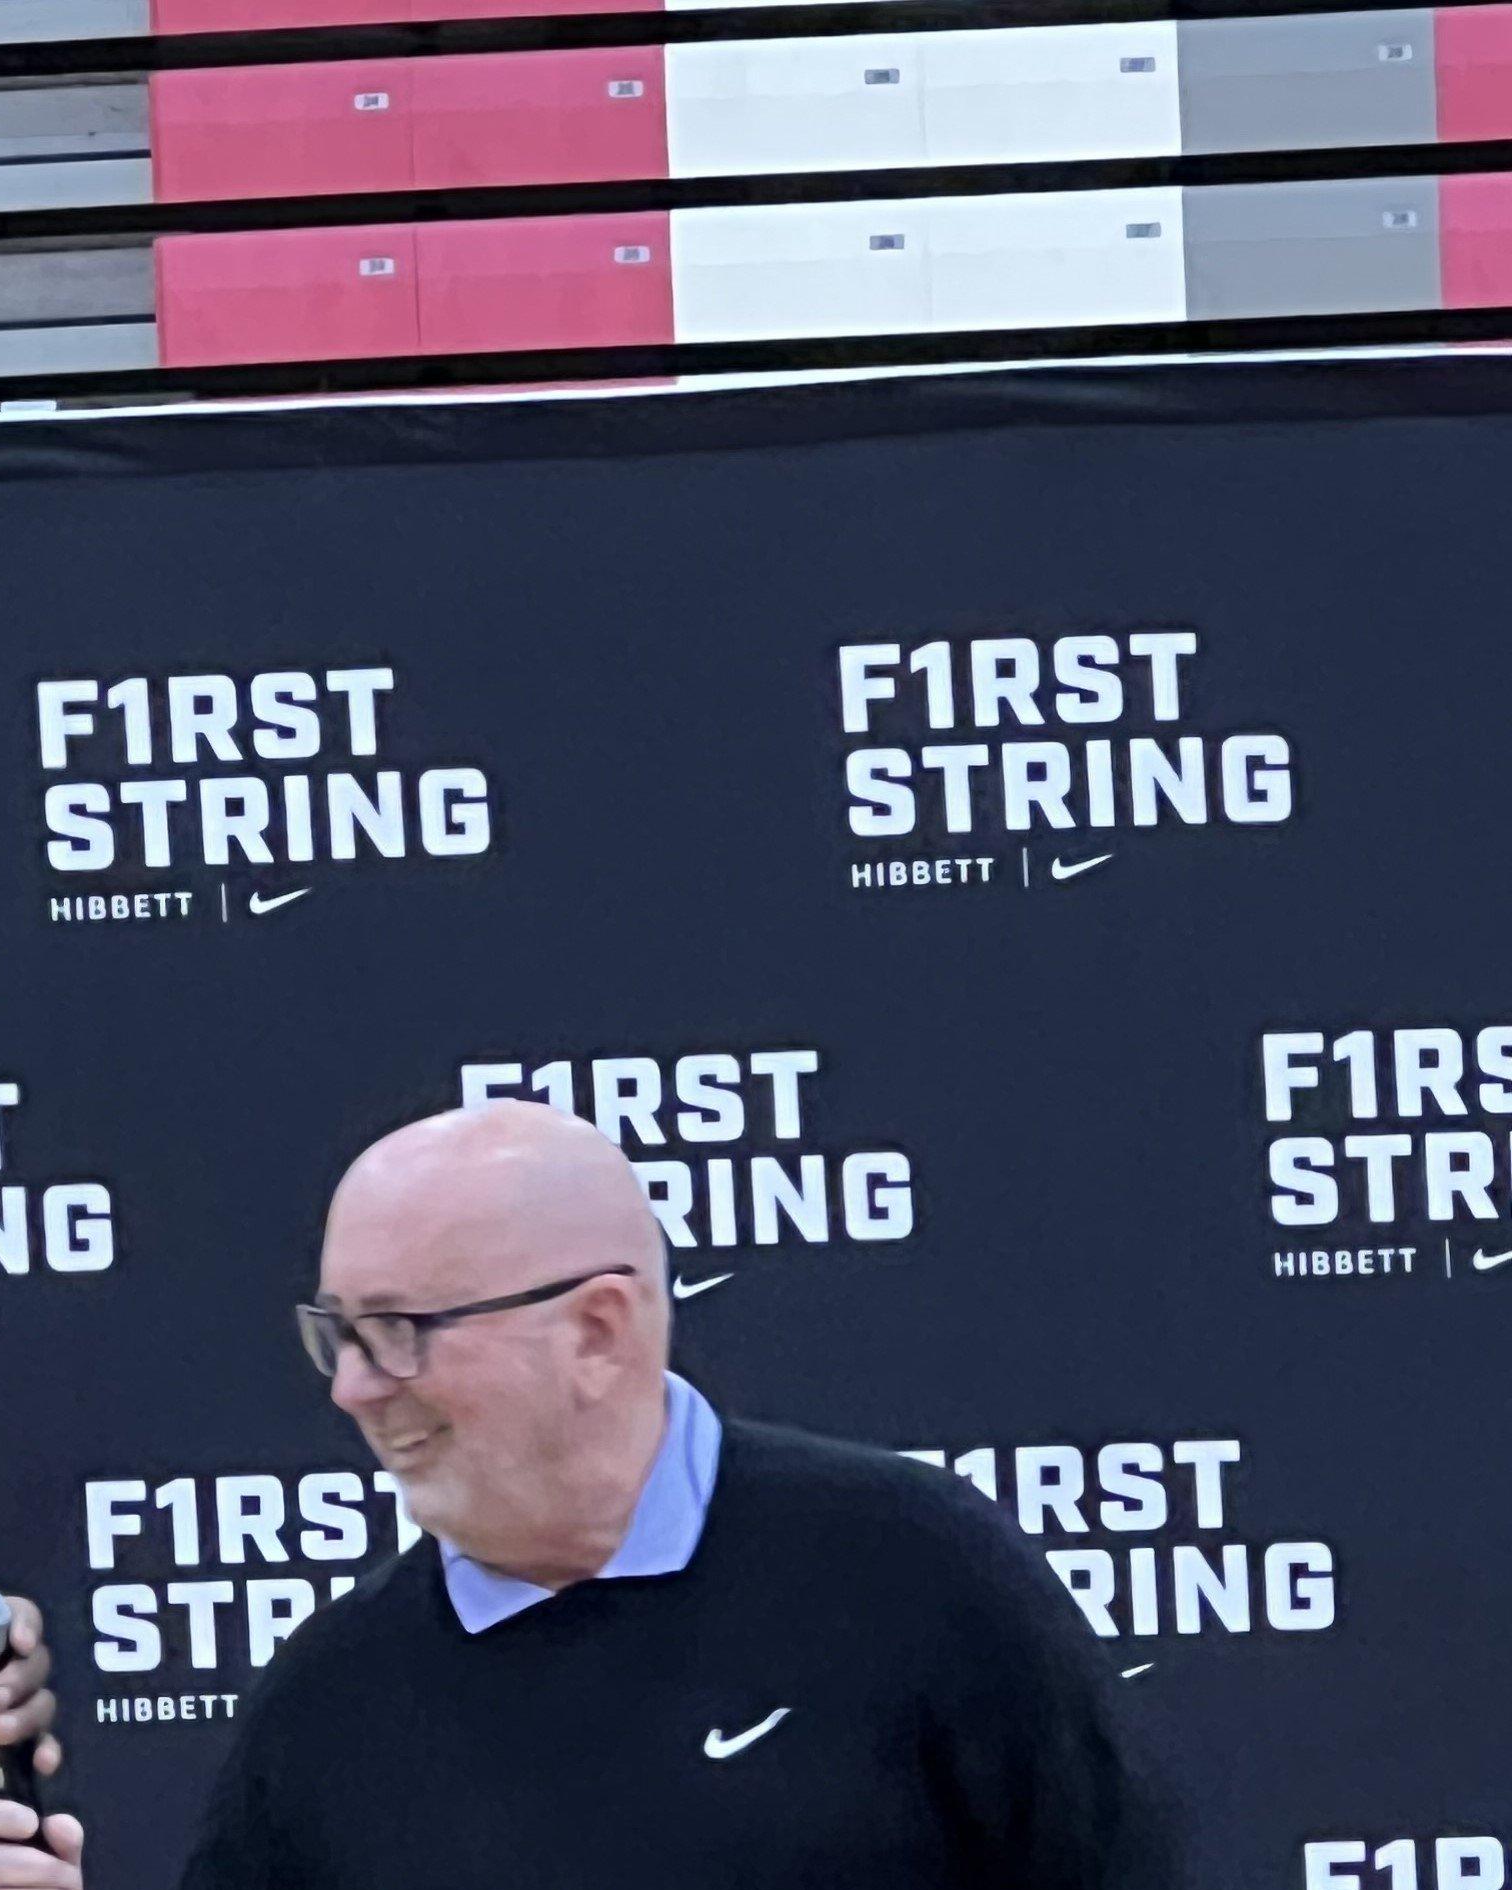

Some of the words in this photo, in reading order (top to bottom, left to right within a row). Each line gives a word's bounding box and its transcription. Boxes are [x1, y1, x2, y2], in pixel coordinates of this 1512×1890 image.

[37, 667, 394, 769] F1RST
[839, 632, 1197, 733] F1RST
[44, 767, 491, 871] STRING
[846, 734, 1292, 837] STRING
[50, 891, 193, 922] HIBBETT
[851, 857, 994, 888] HIBBETT
[1262, 1026, 1512, 1122] F1RS
[630, 1151, 913, 1247] RING
[1269, 1131, 1512, 1226] STR
[1274, 1247, 1417, 1277] HIBBETT
[896, 1439, 1241, 1535] 1RST
[92, 1577, 355, 1672] STR
[1045, 1541, 1335, 1637] RING
[96, 1694, 239, 1723] HIBBETT
